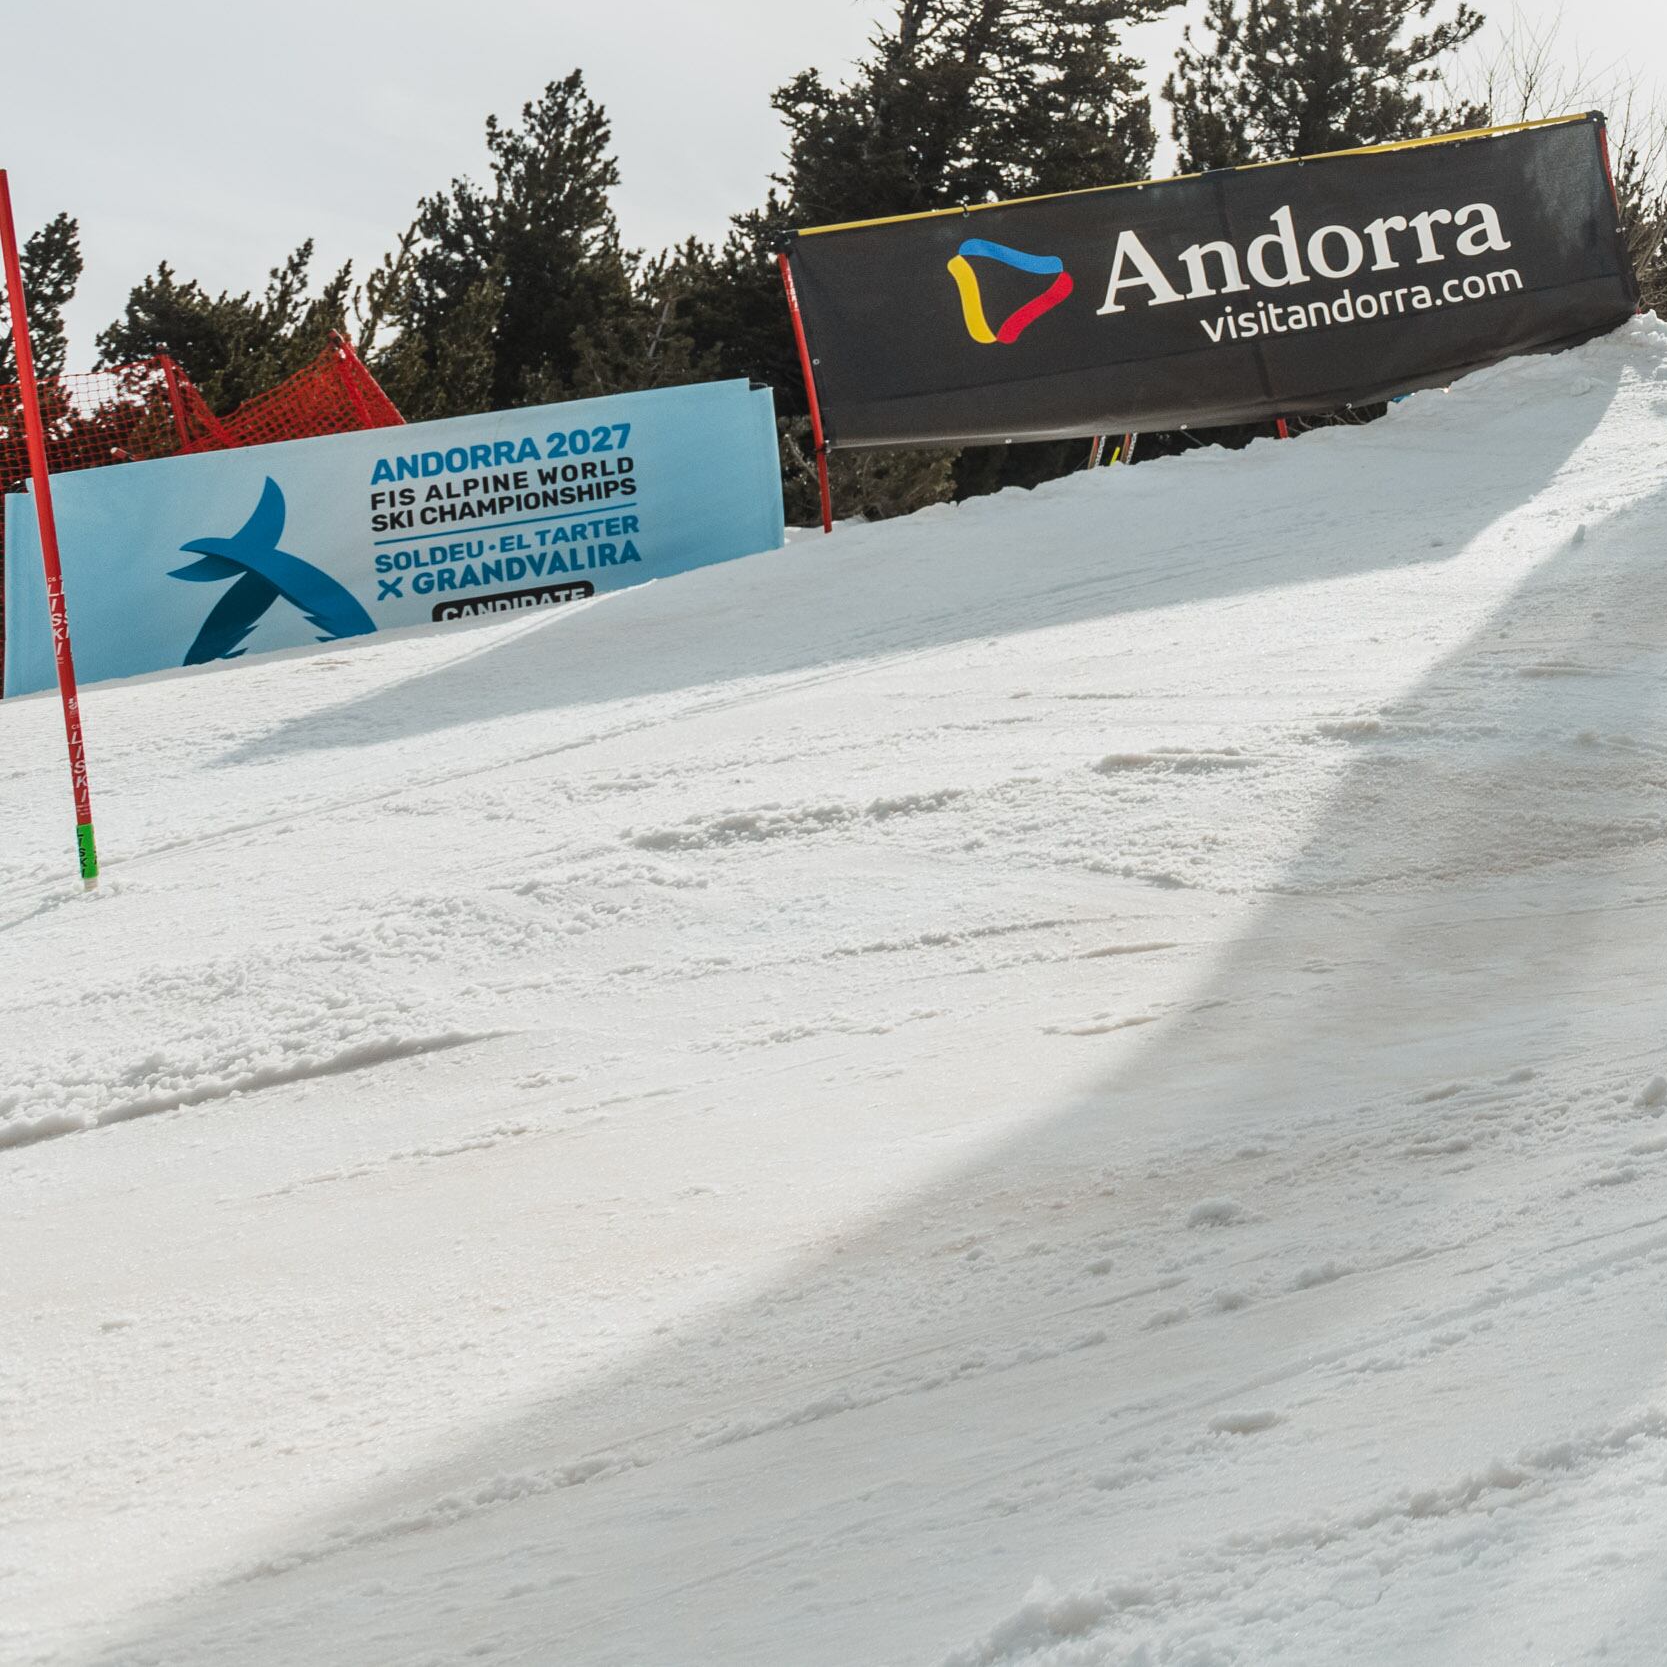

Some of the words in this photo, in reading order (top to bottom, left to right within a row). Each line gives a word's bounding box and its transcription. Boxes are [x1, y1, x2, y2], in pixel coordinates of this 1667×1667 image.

[1097, 200, 1512, 316] Andorra
[1201, 266, 1524, 344] visitandorra.com
[371, 437, 541, 485] ANDORRA
[547, 423, 631, 459] 2027
[371, 488, 416, 511] FIS
[426, 471, 528, 503] ALPINE
[538, 456, 635, 486] WORLD
[371, 509, 414, 532] SKI
[420, 478, 638, 525] CHAMPIONSHIPS
[375, 540, 484, 574] SOLDEU
[500, 535, 531, 554] EL
[535, 515, 641, 546] TARTER
[412, 540, 642, 596] GRANDVALIRA
[47, 584, 65, 659] LISKI
[67, 731, 89, 803] LISKI
